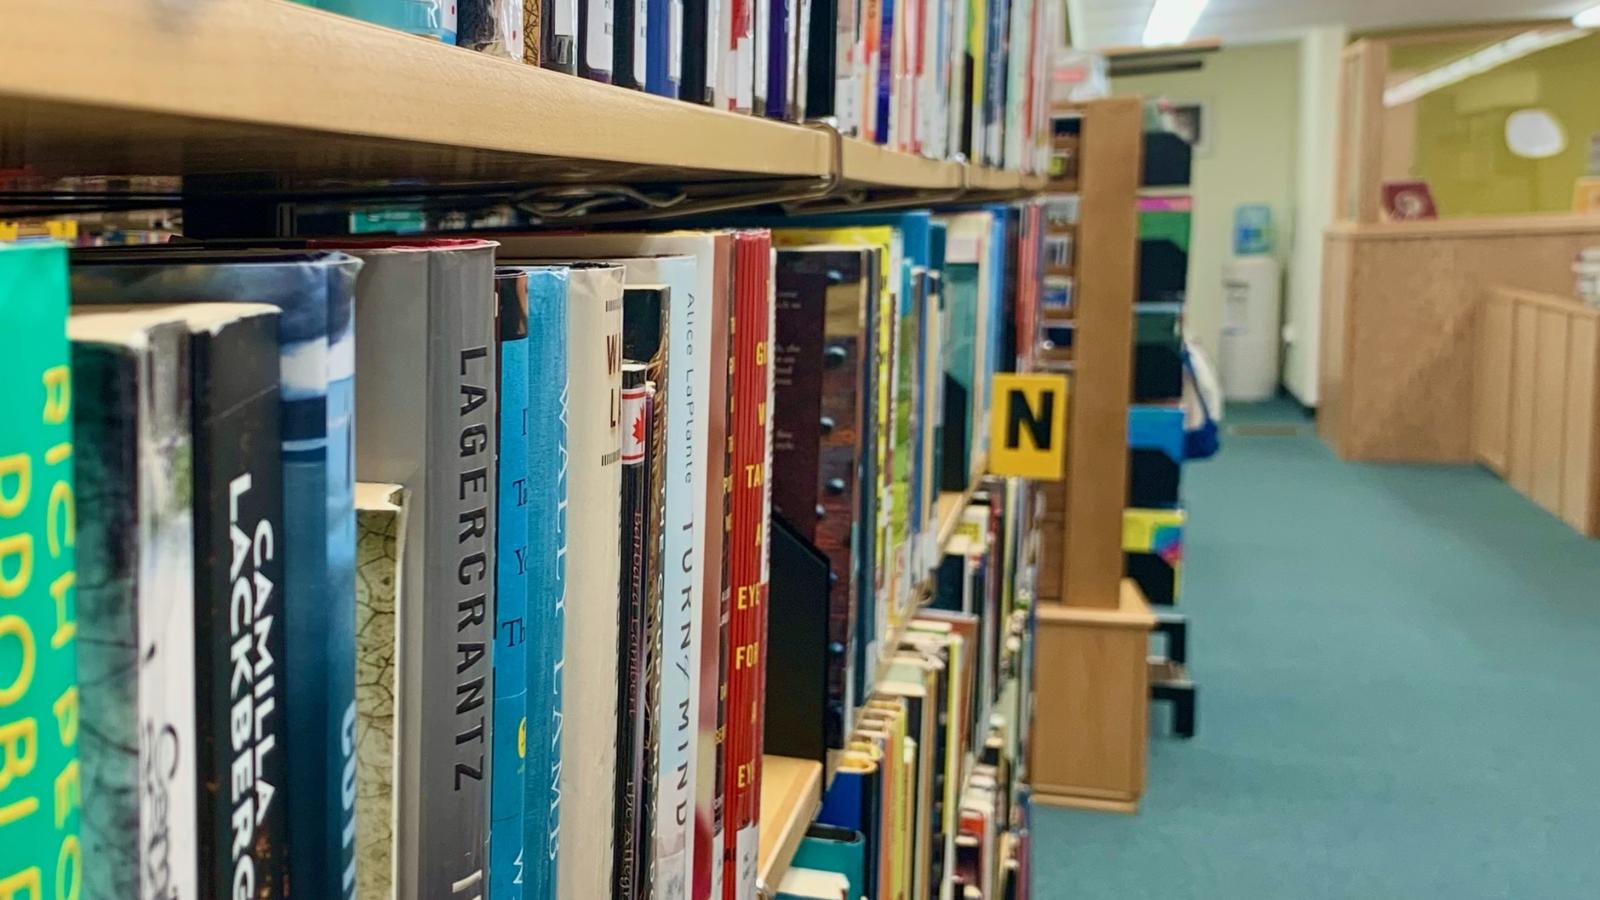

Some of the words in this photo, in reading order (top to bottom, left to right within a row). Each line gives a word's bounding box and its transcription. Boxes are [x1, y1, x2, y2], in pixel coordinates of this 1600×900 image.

[685, 292, 695, 356] Alice
[610, 385, 621, 429] L
[684, 368, 695, 486] LaPlante
[1005, 389, 1054, 451] N
[42, 365, 77, 649] RICH
[555, 374, 570, 618] WALLY
[631, 510, 642, 607] Barbara
[454, 344, 488, 792] LAGERCRANTZ
[681, 522, 693, 651] TURN
[737, 582, 761, 611] EYE
[230, 473, 255, 900] LACKBERG
[253, 518, 276, 827] CAMILLA
[629, 616, 640, 718] Lambert
[655, 572, 664, 725] COUPLE
[549, 657, 566, 861] LAMB
[651, 741, 659, 838] NEXT
[676, 700, 689, 827] MIND
